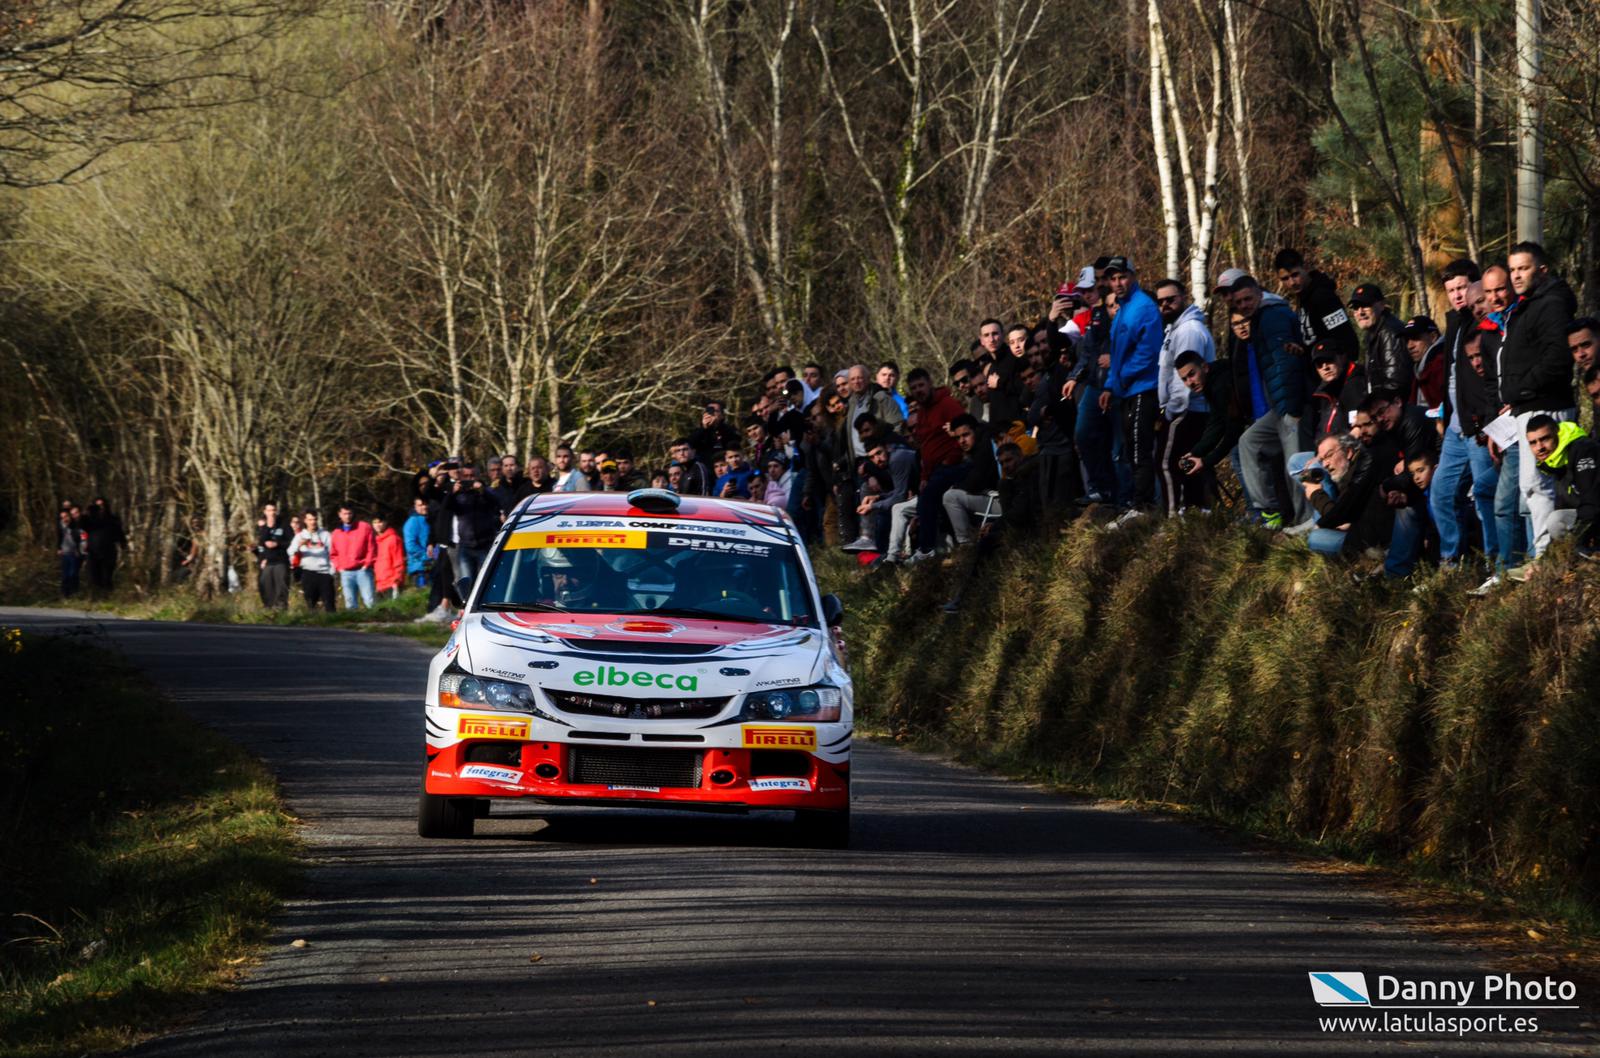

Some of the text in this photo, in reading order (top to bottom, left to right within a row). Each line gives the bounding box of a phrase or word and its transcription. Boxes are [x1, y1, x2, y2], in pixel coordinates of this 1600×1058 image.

[546, 534, 627, 544] PIRELLI
[573, 666, 698, 691] elbeca
[459, 718, 527, 737] PIRELLI
[745, 728, 815, 746] PIRELLI
